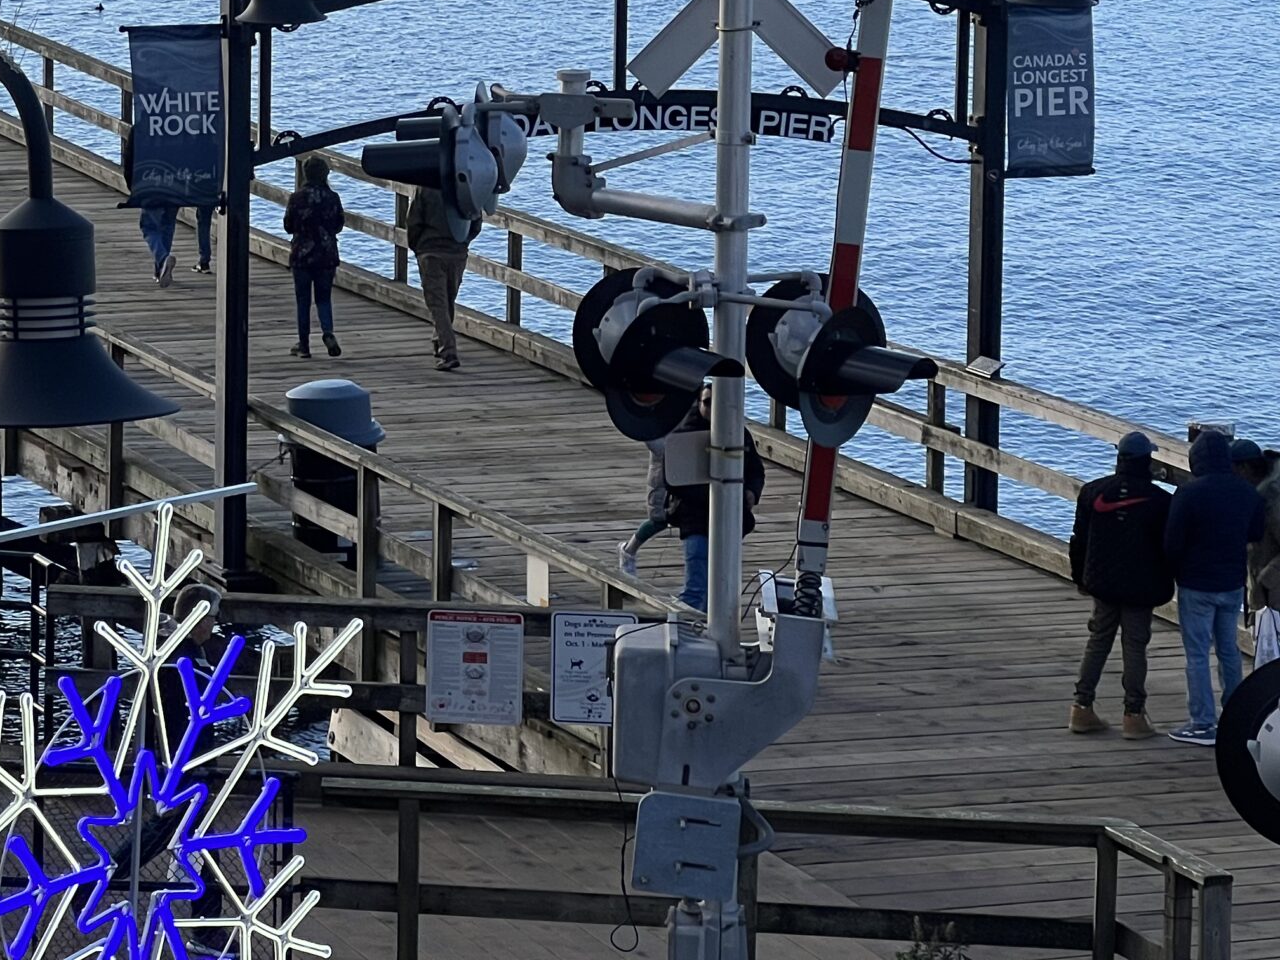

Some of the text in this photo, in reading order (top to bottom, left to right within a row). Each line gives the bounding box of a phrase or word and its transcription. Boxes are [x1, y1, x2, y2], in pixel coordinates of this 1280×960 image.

[1013, 53, 1087, 68] CANADA'S
[1013, 69, 1088, 85] LONGEST
[139, 87, 220, 114] WHITE
[1014, 86, 1090, 117] PIER
[149, 114, 216, 136] ROCK
[595, 105, 831, 142] LONGE PIER
[142, 169, 162, 186] City
[162, 168, 175, 186] by
[194, 164, 216, 183] Sea!
[564, 620, 581, 628] Dogs
